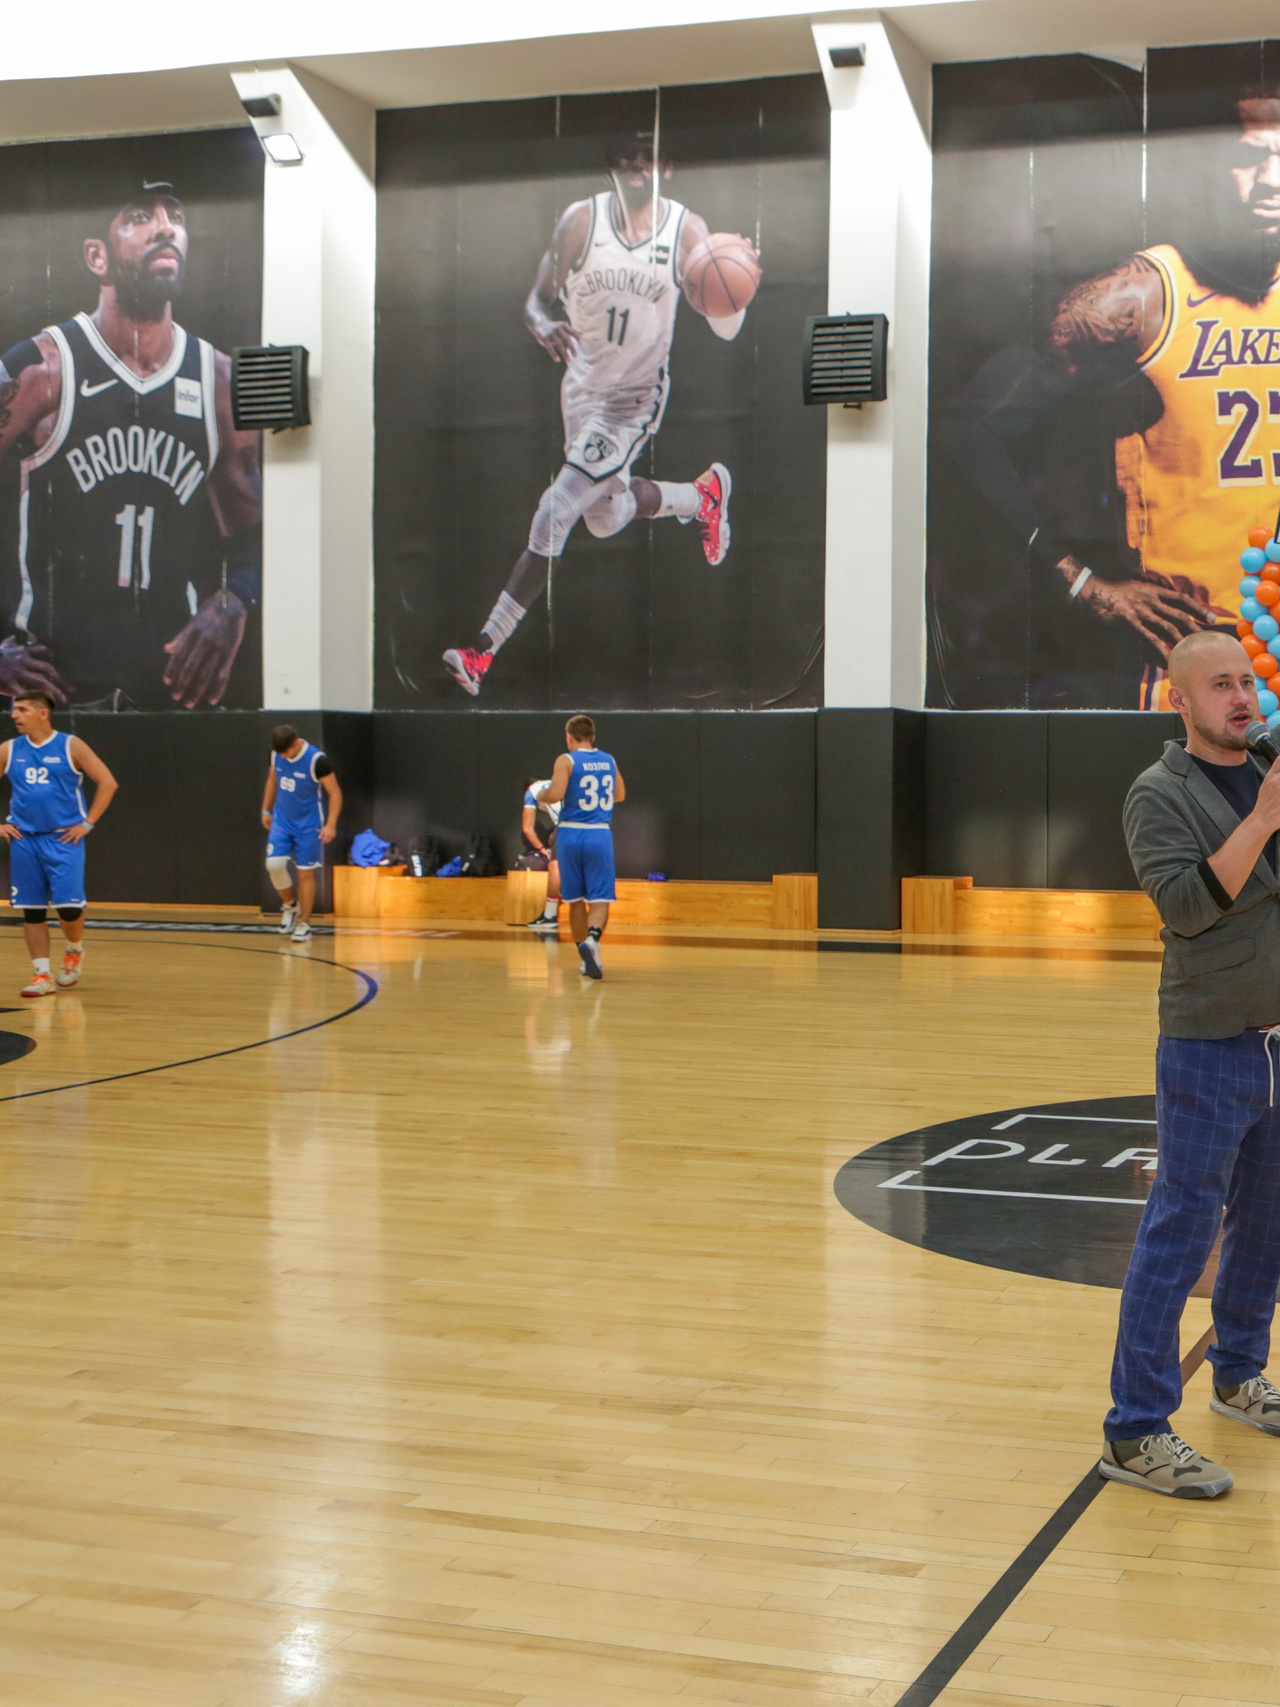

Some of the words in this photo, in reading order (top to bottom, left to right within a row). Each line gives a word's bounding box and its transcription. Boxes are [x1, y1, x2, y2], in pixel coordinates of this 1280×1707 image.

[584, 267, 670, 304] BROOKLYN
[606, 305, 630, 346] 11
[66, 425, 205, 506] BROOKLYN
[115, 504, 155, 590] 11
[25, 767, 50, 784] 92
[578, 775, 613, 811] 33
